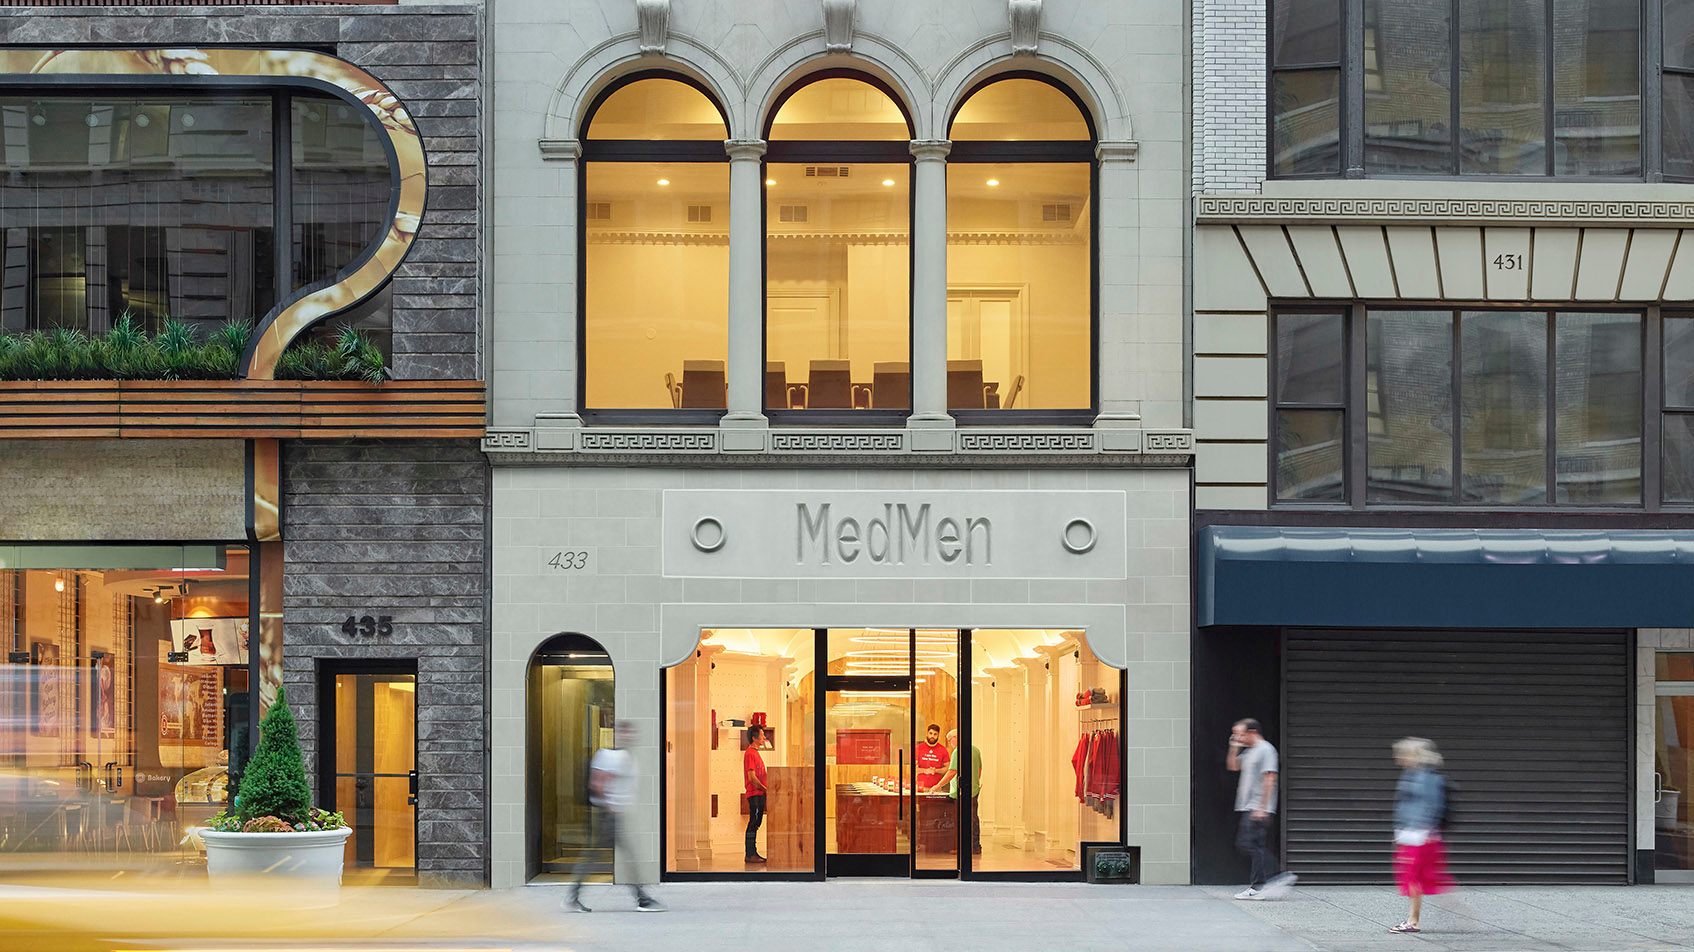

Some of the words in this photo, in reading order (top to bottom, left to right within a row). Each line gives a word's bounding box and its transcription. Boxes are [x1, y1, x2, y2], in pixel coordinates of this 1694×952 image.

[1493, 254, 1522, 270] 431
[796, 503, 992, 566] MedMen
[548, 551, 588, 569] 433
[341, 615, 393, 638] 435
[147, 774, 171, 782] Bakery
